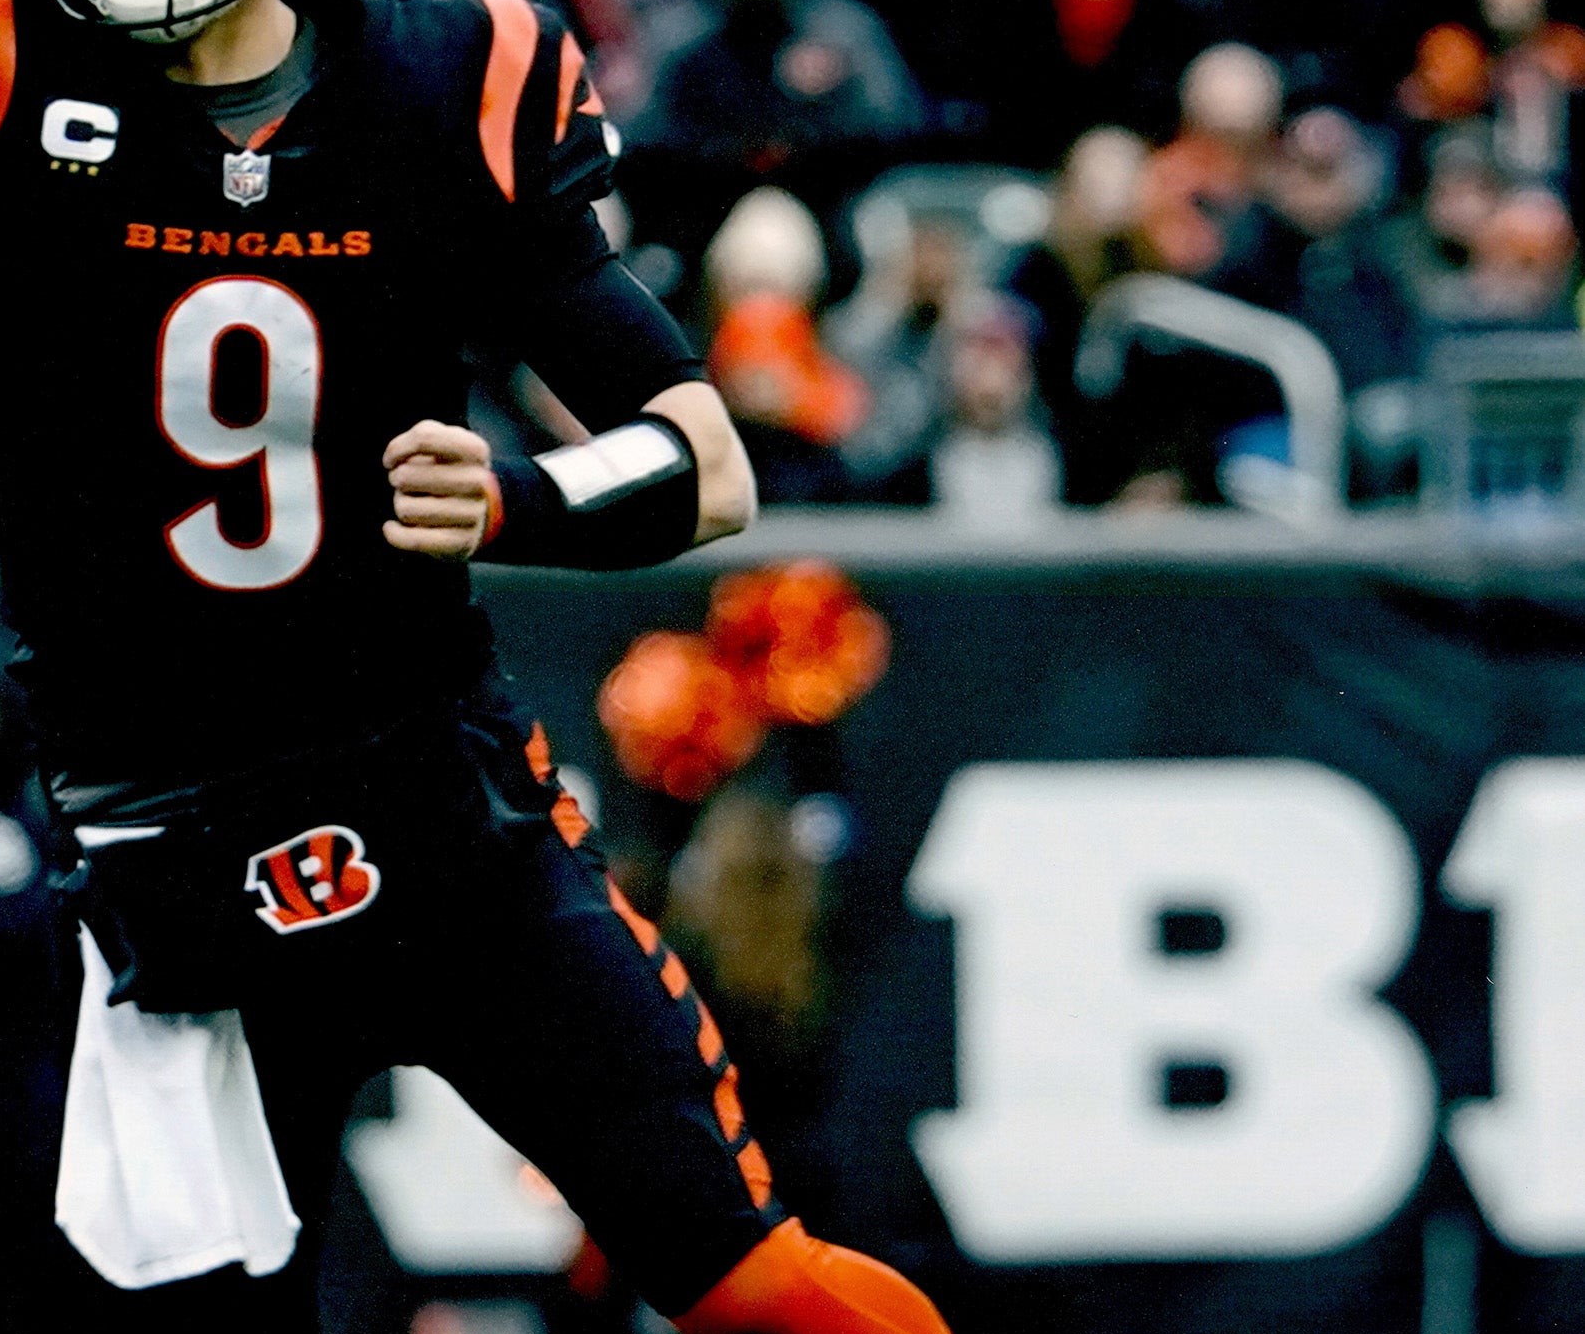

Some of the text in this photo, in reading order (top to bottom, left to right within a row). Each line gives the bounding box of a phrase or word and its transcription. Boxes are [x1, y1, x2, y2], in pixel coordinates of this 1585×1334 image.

[40, 98, 119, 163] C
[124, 223, 372, 257] BENGALS
[156, 274, 324, 591] 9
